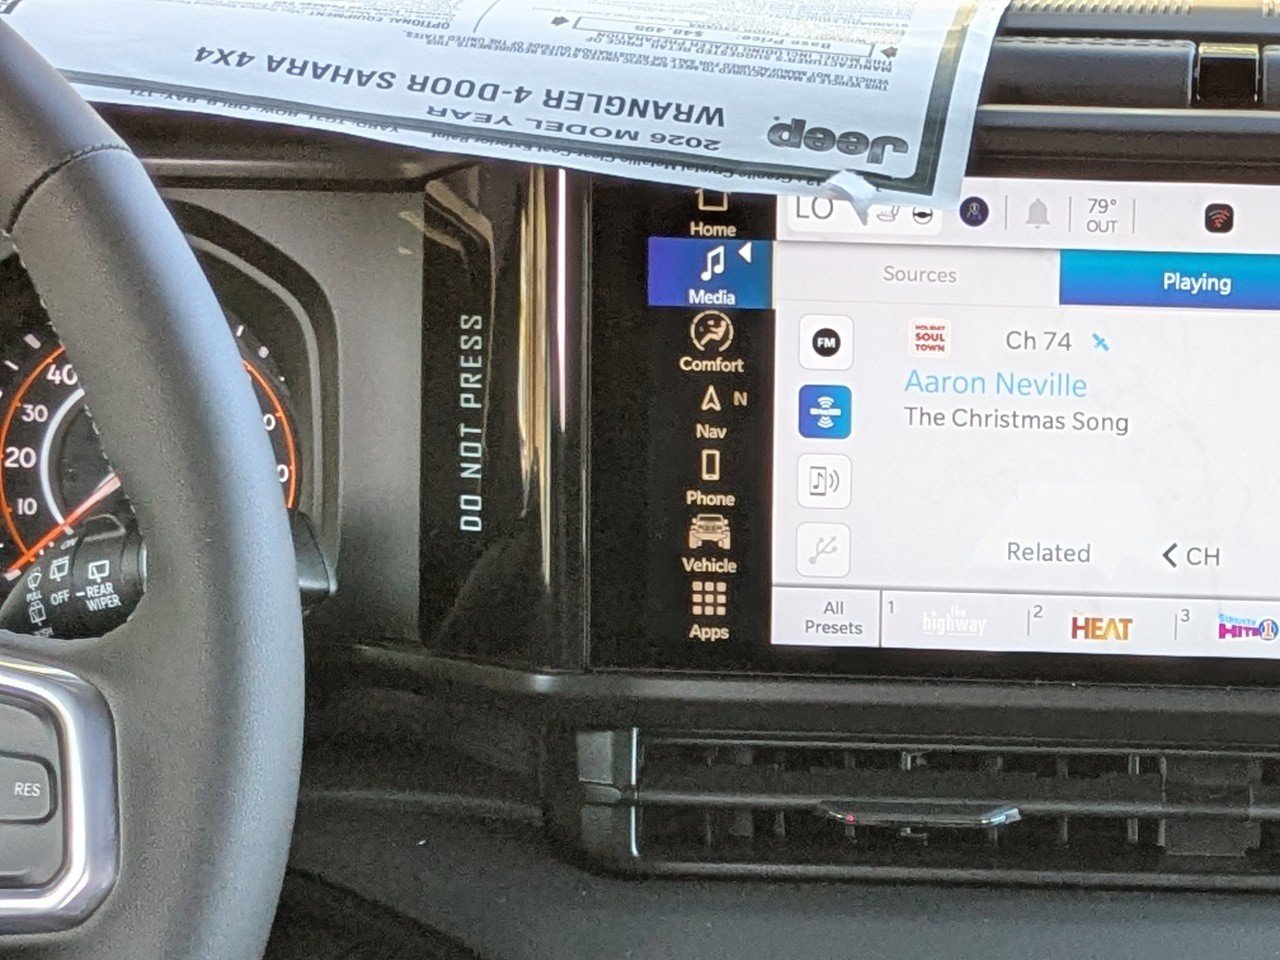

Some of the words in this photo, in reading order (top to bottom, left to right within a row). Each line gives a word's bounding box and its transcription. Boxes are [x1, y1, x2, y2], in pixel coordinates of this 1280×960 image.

[388, 17, 450, 30] OPTIONAL
[447, 35, 485, 44] UNITED
[527, 42, 572, 52] OUTSIDE
[596, 32, 686, 47] PREPARATION
[605, 39, 644, 47] PRICE
[650, 43, 692, 52] RETAIL
[690, 42, 739, 52] DEALER
[791, 40, 831, 49] Base
[195, 46, 256, 69] 4X4
[541, 49, 578, 59] STATES
[574, 47, 650, 61] REGISTRATION
[581, 54, 619, 63] UNITED
[696, 48, 771, 61] SUGGESTED
[622, 58, 668, 68] SPECIFIC
[671, 63, 698, 71] MEET
[723, 63, 807, 77] MANUFACTURED
[266, 53, 398, 91] SAHARA
[719, 68, 803, 82] MANUFACTURED
[408, 73, 532, 105] 4-DOOR
[819, 79, 862, 88] VEHICLE
[865, 83, 888, 91] THIS
[426, 105, 515, 127] YEAR
[543, 88, 725, 128] WRANGLER
[430, 131, 470, 143] Paint
[526, 118, 640, 142] MODEL
[650, 131, 721, 151] 2026
[766, 117, 910, 165] Jeep
[796, 197, 834, 219] LO
[1087, 198, 1117, 215] 79°
[690, 222, 736, 238] Home
[1086, 219, 1117, 234] OUT
[883, 265, 957, 285] Sources
[1163, 273, 1232, 296] Playing
[688, 289, 736, 306] Media
[817, 337, 836, 348] FM
[915, 333, 945, 342] SOUL
[1005, 330, 1037, 350] Ch
[1043, 332, 1072, 351] 74
[915, 344, 945, 352] TOWN
[460, 314, 482, 409] PRESS
[680, 356, 744, 373] Comfort
[46, 362, 78, 385] 40
[904, 369, 986, 396] Aaron
[997, 372, 1088, 398] Neville
[734, 391, 748, 406] N
[21, 404, 48, 422] 30
[904, 407, 946, 428] The
[951, 409, 1066, 432] Christmas
[1071, 414, 1130, 436] Song
[696, 423, 727, 439] Nav
[4, 447, 37, 468] 20
[460, 423, 482, 479] NOT
[686, 490, 736, 507] Phone
[17, 498, 38, 516] 10
[460, 494, 482, 532] DO
[1007, 542, 1091, 564] Related
[1186, 547, 1221, 566] CH
[682, 557, 738, 574] Vehicle
[50, 589, 71, 605] OFF
[86, 582, 115, 598] REAR
[85, 594, 122, 612] WIPER
[823, 601, 844, 615] All
[888, 601, 894, 613] 1
[1033, 605, 1043, 618] 2
[1180, 609, 1190, 622] 3
[804, 619, 863, 637] Presets
[922, 611, 987, 636] highway
[1071, 617, 1133, 640] HEAT
[689, 625, 730, 642] Apps
[14, 781, 41, 797] RES
